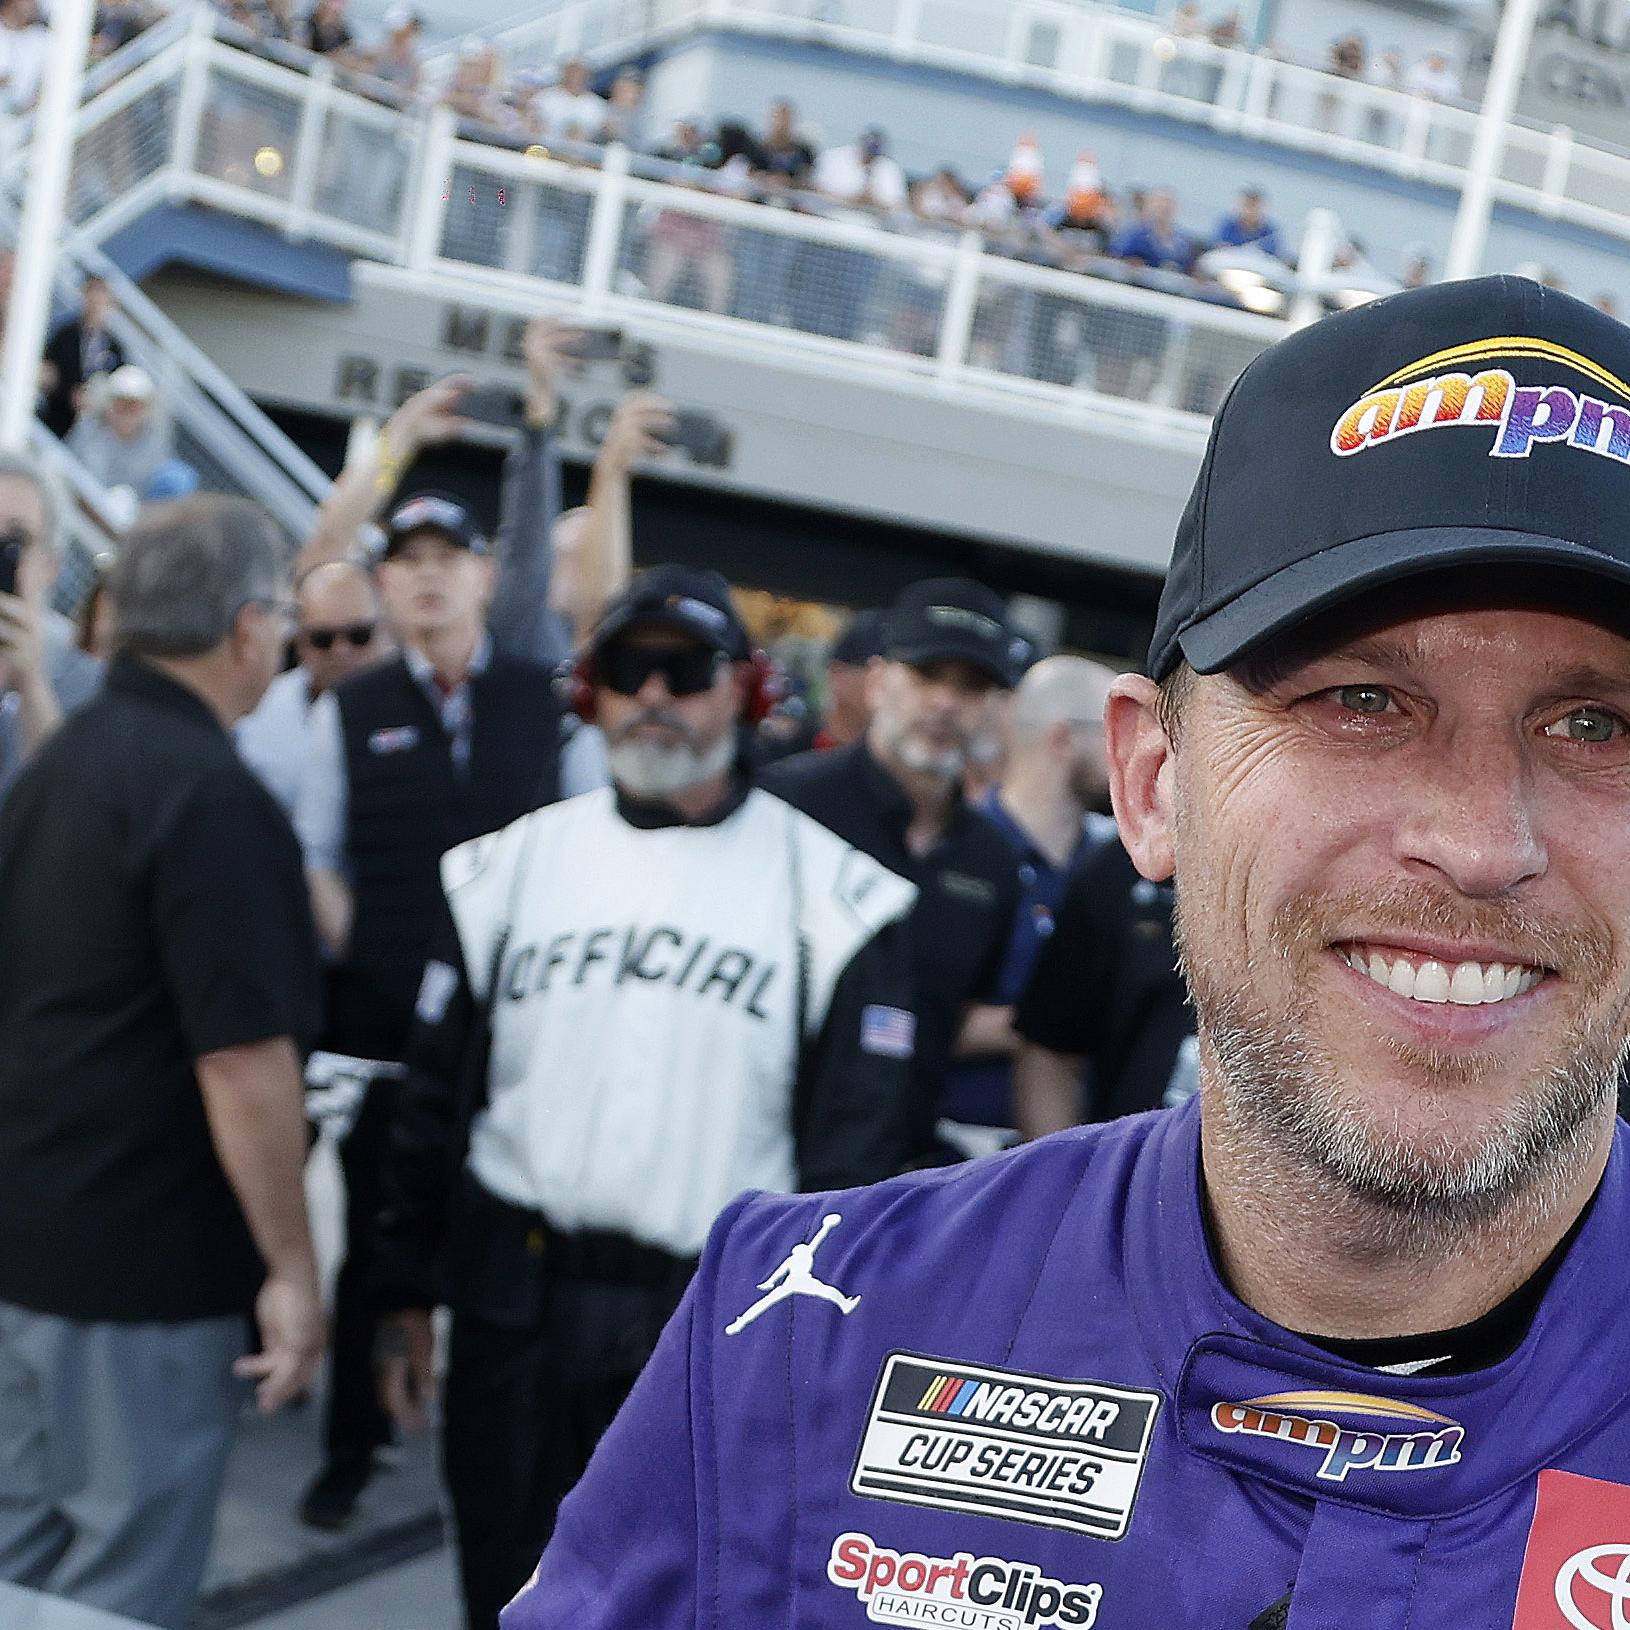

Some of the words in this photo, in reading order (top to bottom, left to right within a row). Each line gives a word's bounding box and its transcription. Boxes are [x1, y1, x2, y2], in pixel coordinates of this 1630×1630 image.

[501, 920, 777, 1022] OFFICIAL
[964, 1383, 1121, 1440] NASCAR
[1211, 1402, 1465, 1481] ampm
[898, 1434, 973, 1475] CUP
[971, 1445, 1103, 1496] SERIES
[833, 1538, 1095, 1626] SportClips
